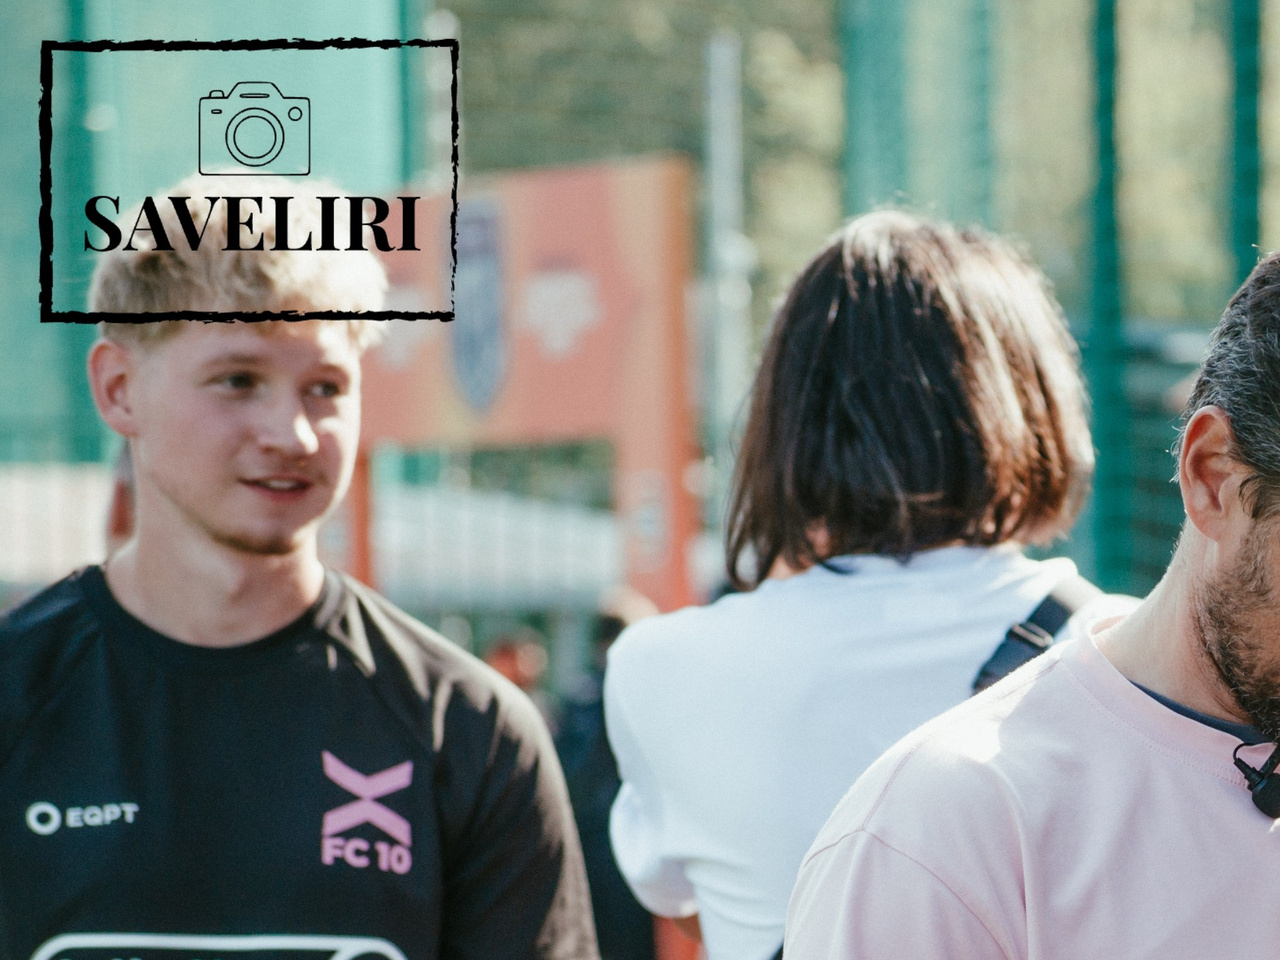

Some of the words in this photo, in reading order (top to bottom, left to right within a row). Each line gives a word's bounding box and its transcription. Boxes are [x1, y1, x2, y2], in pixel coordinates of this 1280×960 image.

[65, 802, 140, 828] EQPT
[321, 836, 370, 868] FC
[374, 840, 412, 875] 10
